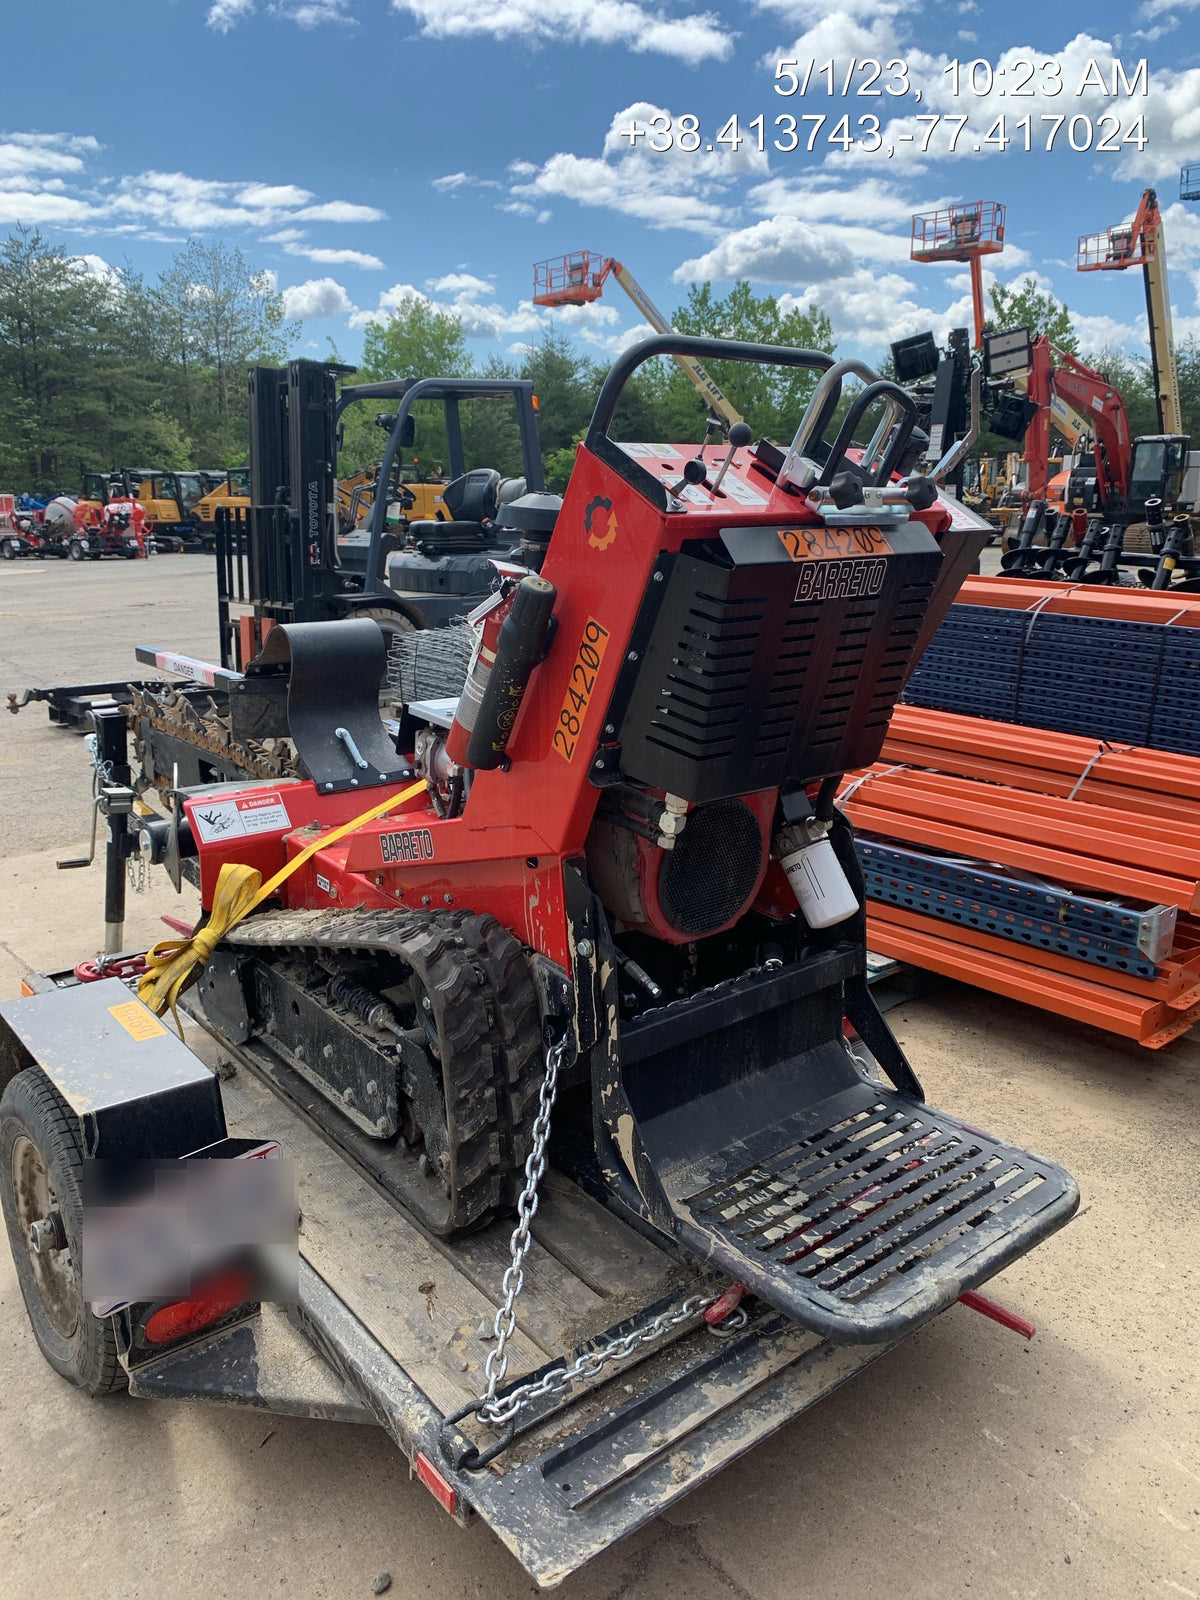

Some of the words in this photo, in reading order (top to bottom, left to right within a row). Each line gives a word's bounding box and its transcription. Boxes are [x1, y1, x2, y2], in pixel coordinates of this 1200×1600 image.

[691, 364, 708, 382] JLG
[706, 381, 725, 402] LIFT
[308, 481, 319, 538] TOYOTA
[783, 526, 891, 559] 284209
[794, 557, 888, 602] BARRETO
[173, 661, 195, 678] DANGER
[553, 620, 609, 760] 284209
[248, 797, 276, 808] DANGER
[379, 828, 434, 864] BARRETO
